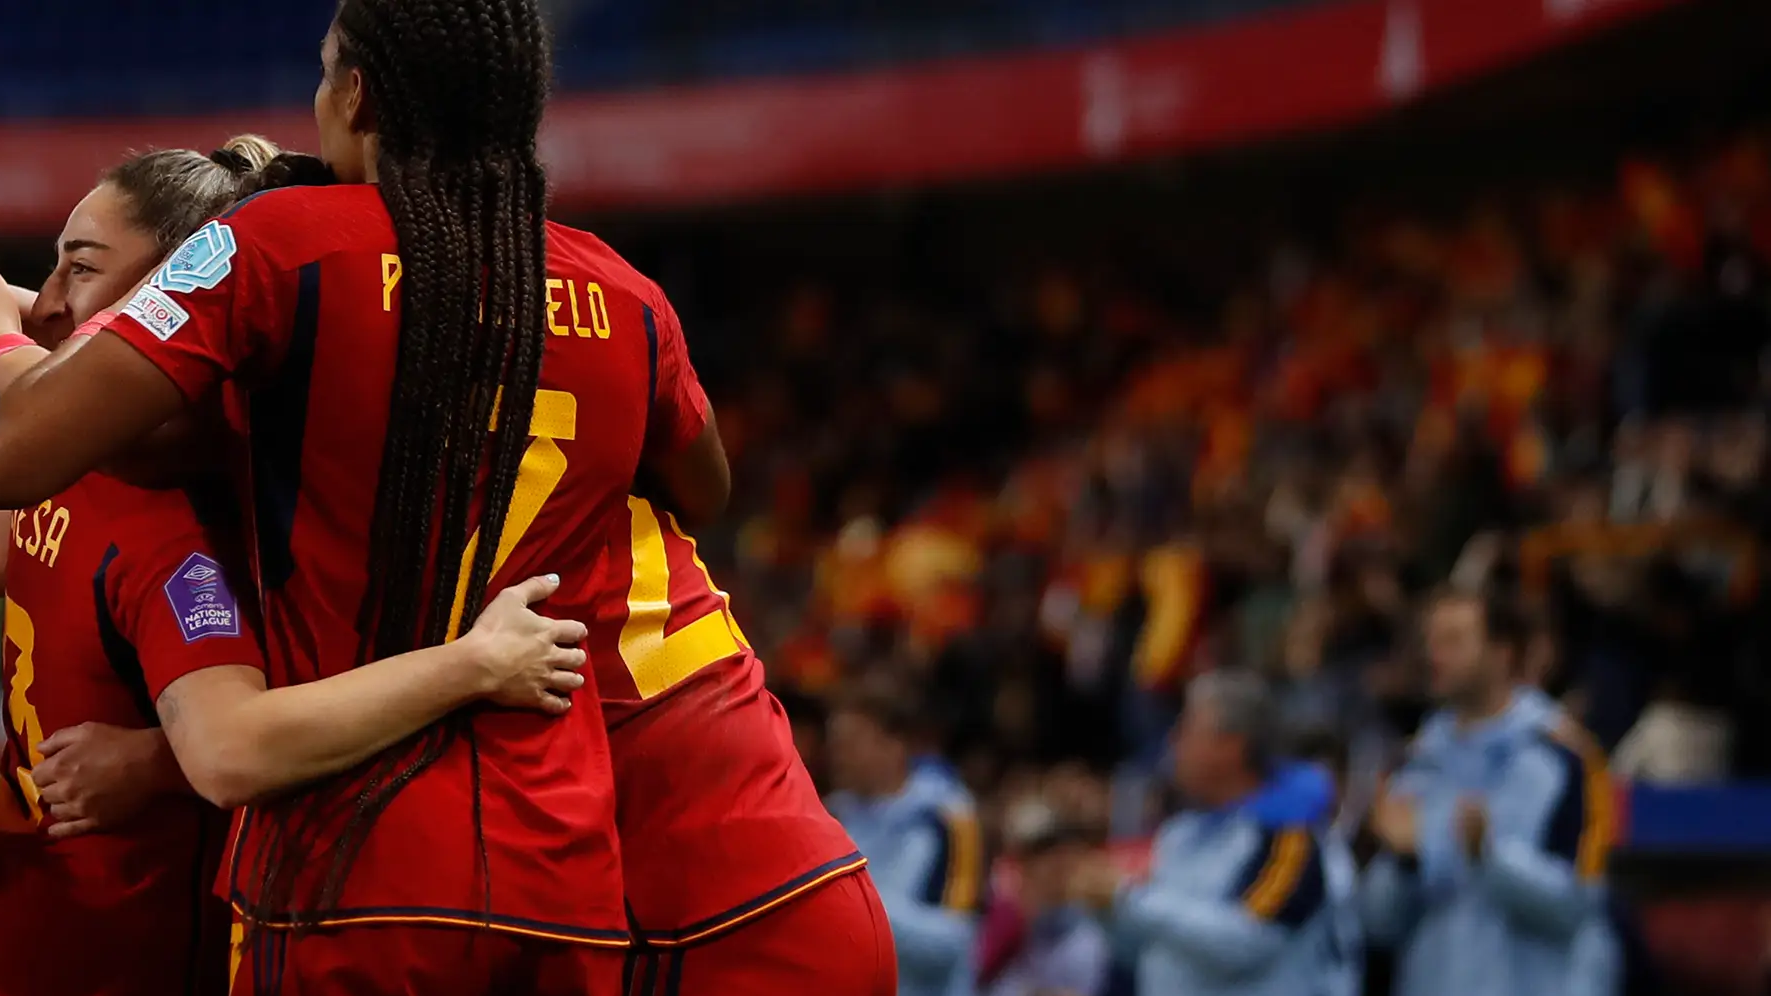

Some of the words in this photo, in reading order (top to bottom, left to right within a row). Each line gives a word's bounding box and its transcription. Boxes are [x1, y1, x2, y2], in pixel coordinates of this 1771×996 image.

[136, 296, 179, 330] ATION
[184, 609, 232, 625] NATIONS
[189, 617, 231, 631] LEAGUE
